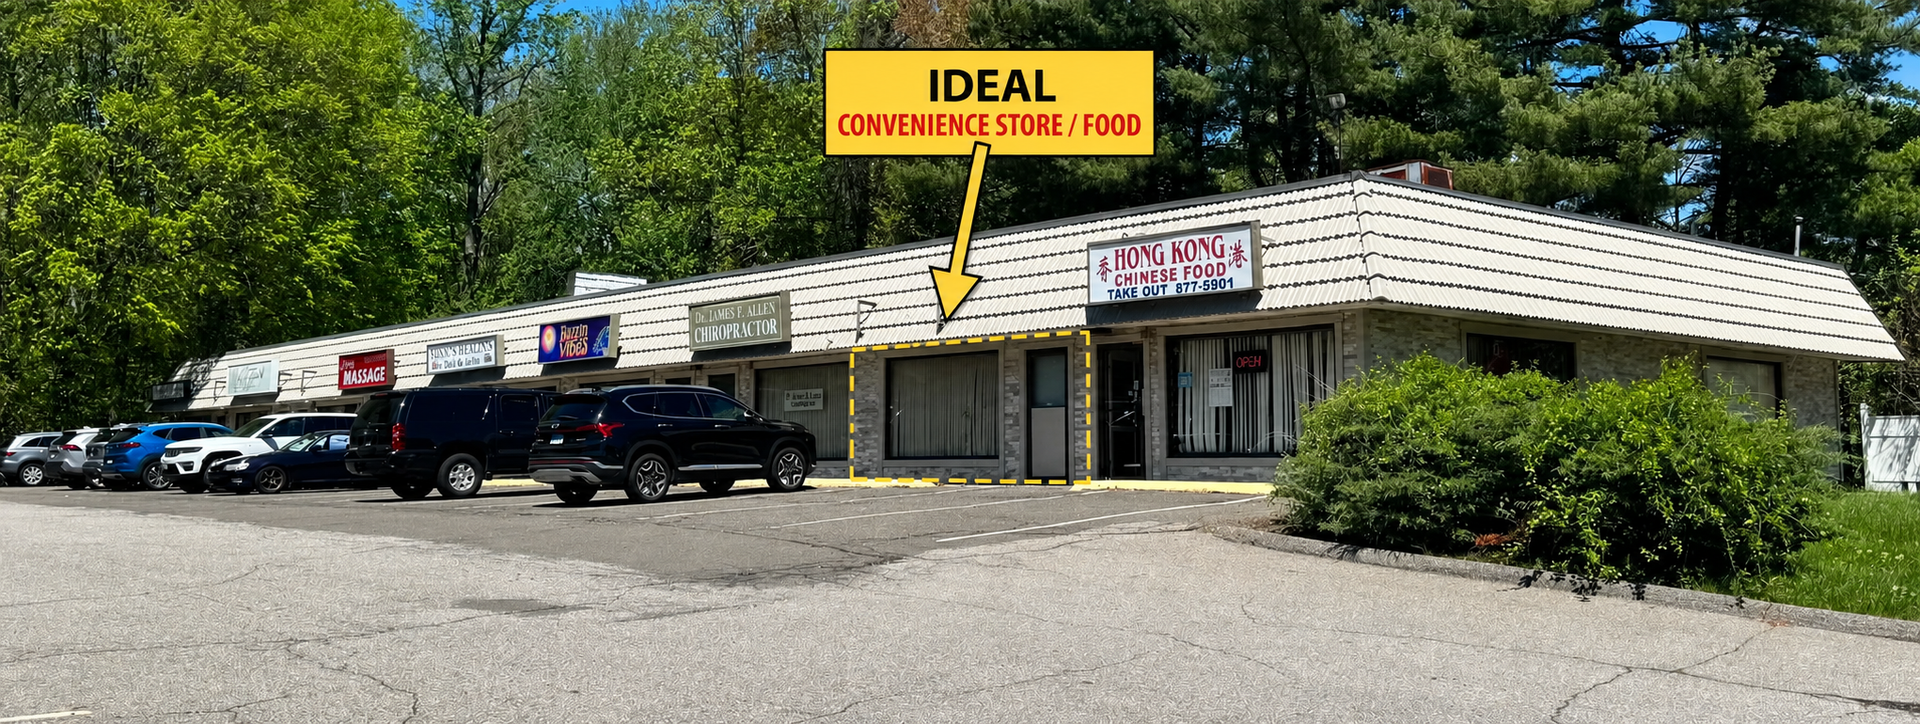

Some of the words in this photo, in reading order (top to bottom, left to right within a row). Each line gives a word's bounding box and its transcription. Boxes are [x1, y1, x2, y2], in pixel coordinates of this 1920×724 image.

[1114, 243, 1165, 271] HONG
[1171, 235, 1226, 264] KONG
[1114, 268, 1177, 287] CHINESE
[1183, 262, 1226, 281] FOOD
[1107, 287, 1138, 300] TAKE
[1142, 284, 1168, 297] OUT
[1175, 277, 1234, 294] 877-5901
[709, 306, 735, 322] JAMES
[747, 301, 776, 317] ALLEN
[694, 318, 777, 343] CHIROPRACTOR
[343, 366, 386, 386] MASSAGE
